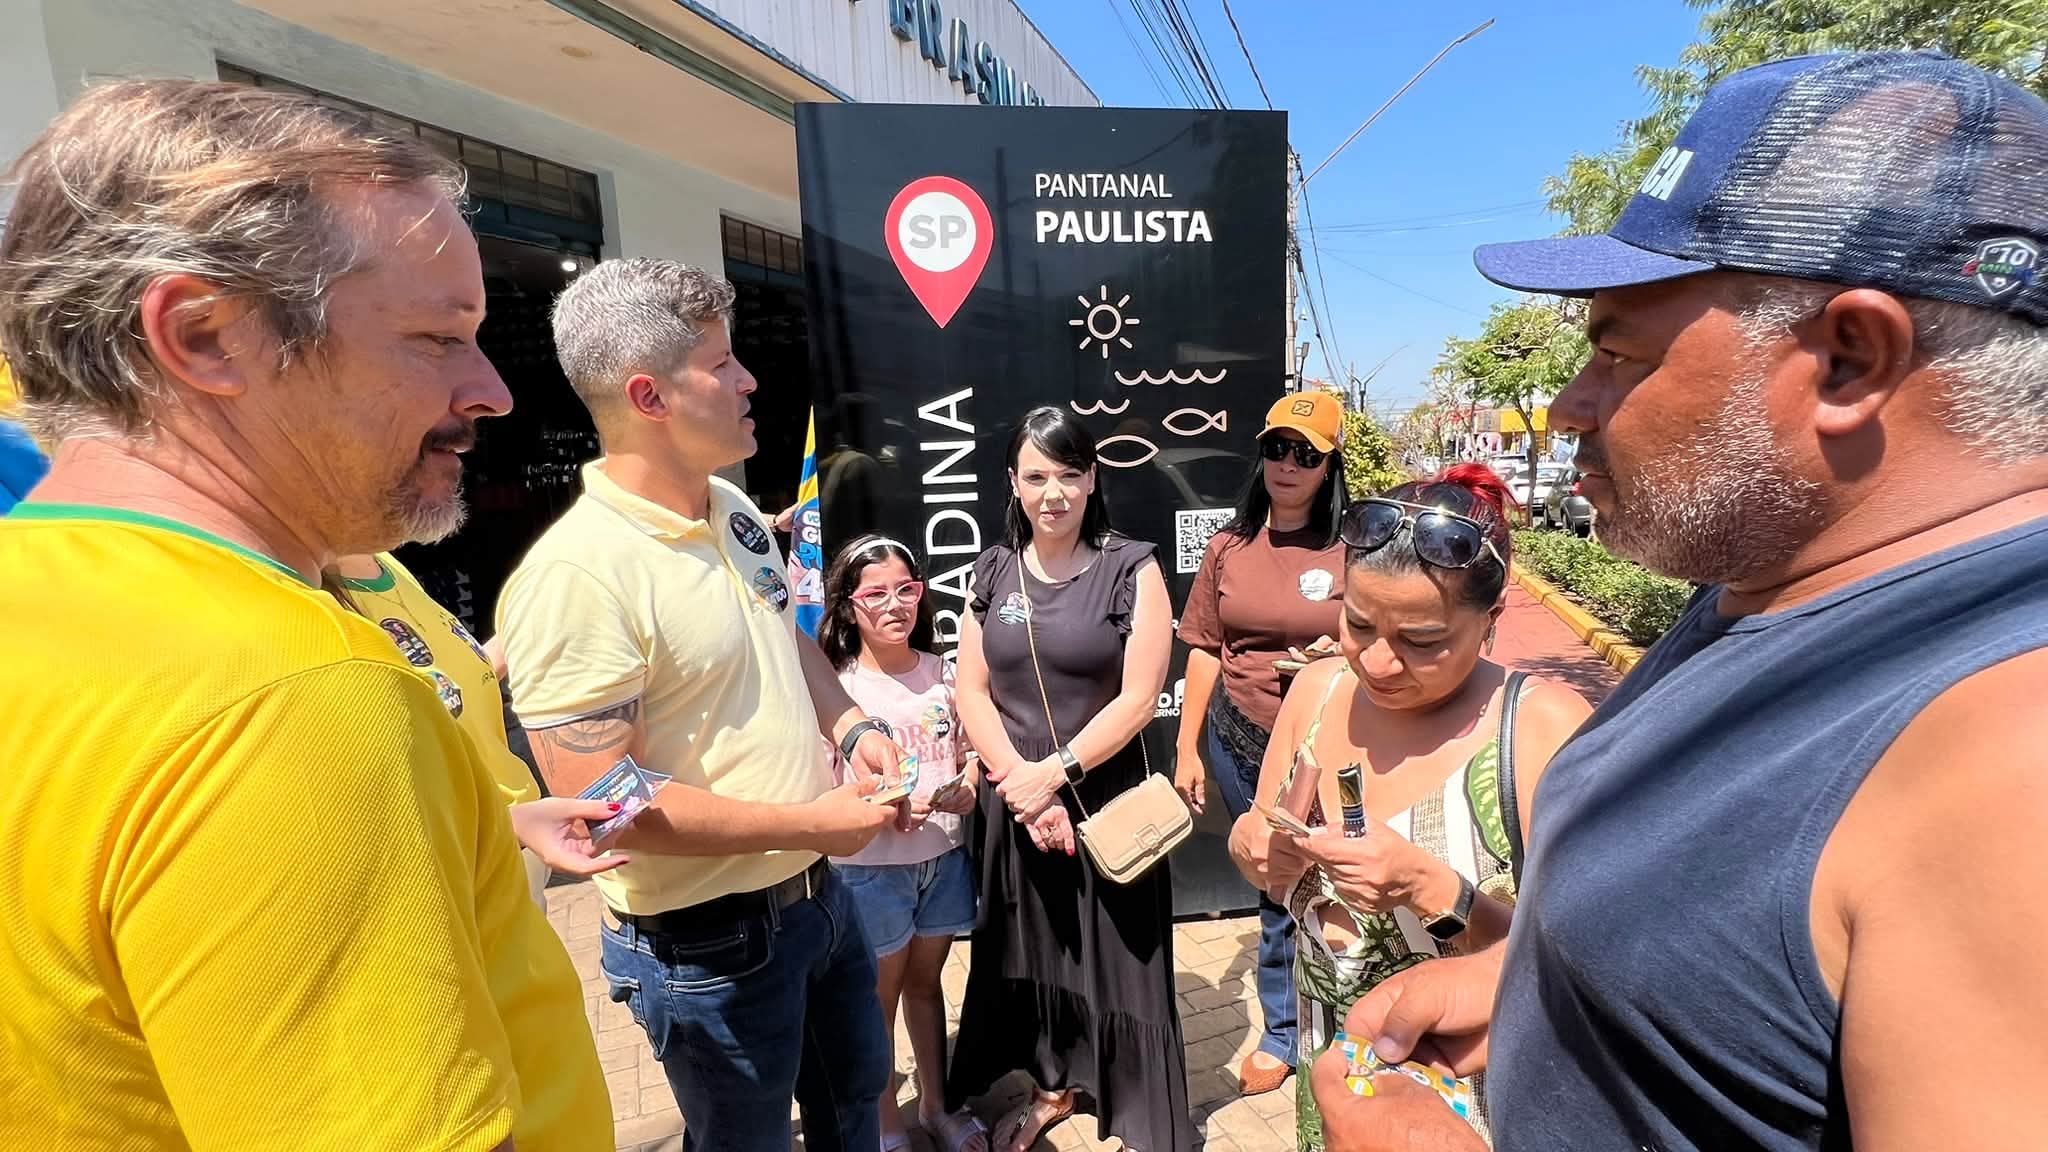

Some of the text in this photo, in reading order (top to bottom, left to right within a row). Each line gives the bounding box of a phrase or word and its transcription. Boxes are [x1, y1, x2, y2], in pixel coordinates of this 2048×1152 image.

[1035, 173, 1173, 198] PANTANAL
[908, 214, 967, 249] SP
[1036, 210, 1213, 243] PAULISTA
